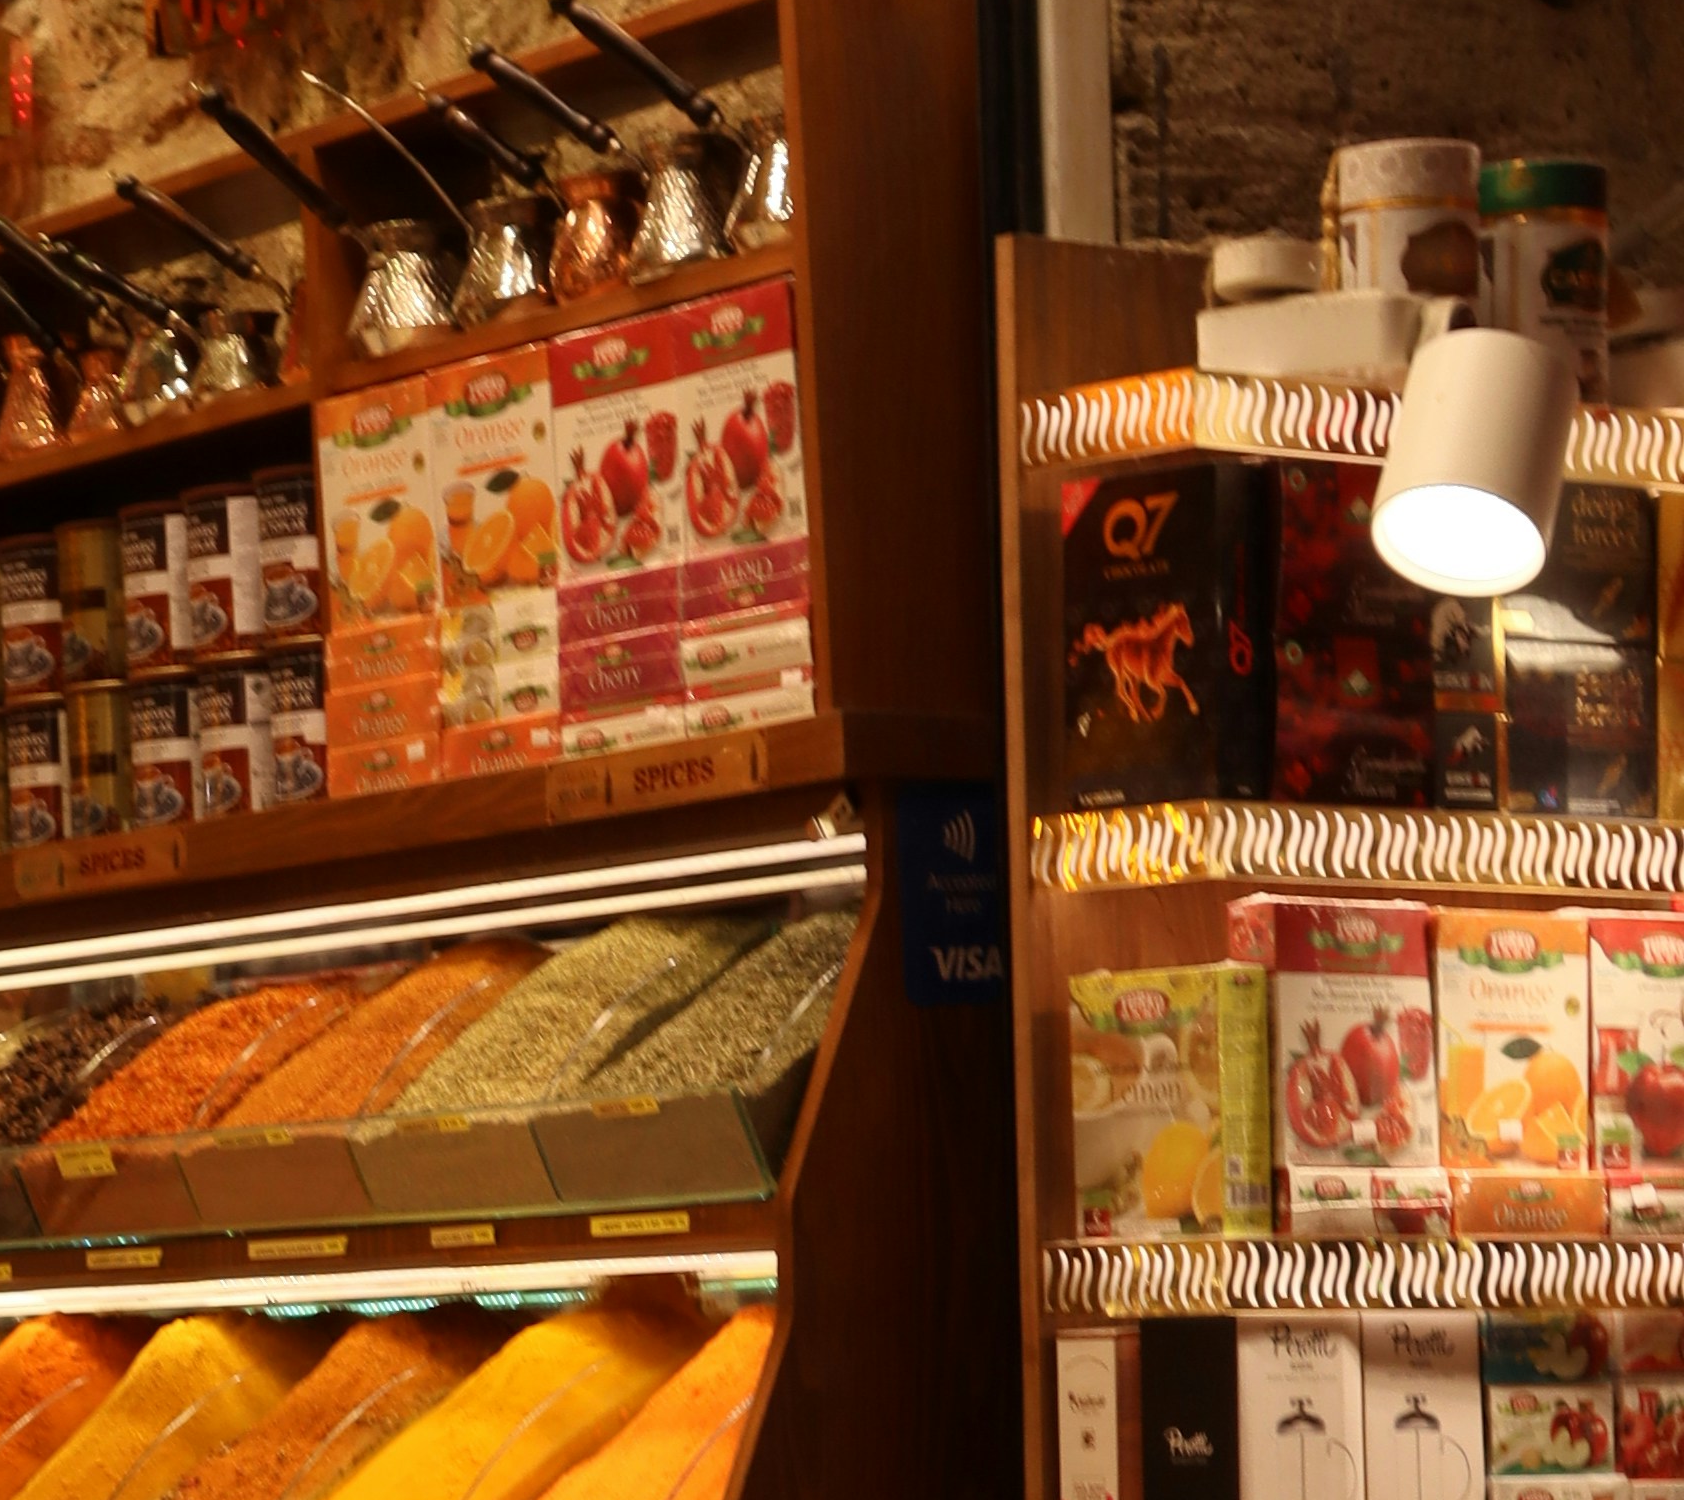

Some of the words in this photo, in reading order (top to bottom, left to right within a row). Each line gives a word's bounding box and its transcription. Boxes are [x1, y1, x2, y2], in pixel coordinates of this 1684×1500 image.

[1101, 489, 1179, 561] Q7
[633, 755, 715, 793] SPICES
[78, 847, 147, 877] SPICES
[929, 945, 1006, 982] VISA
